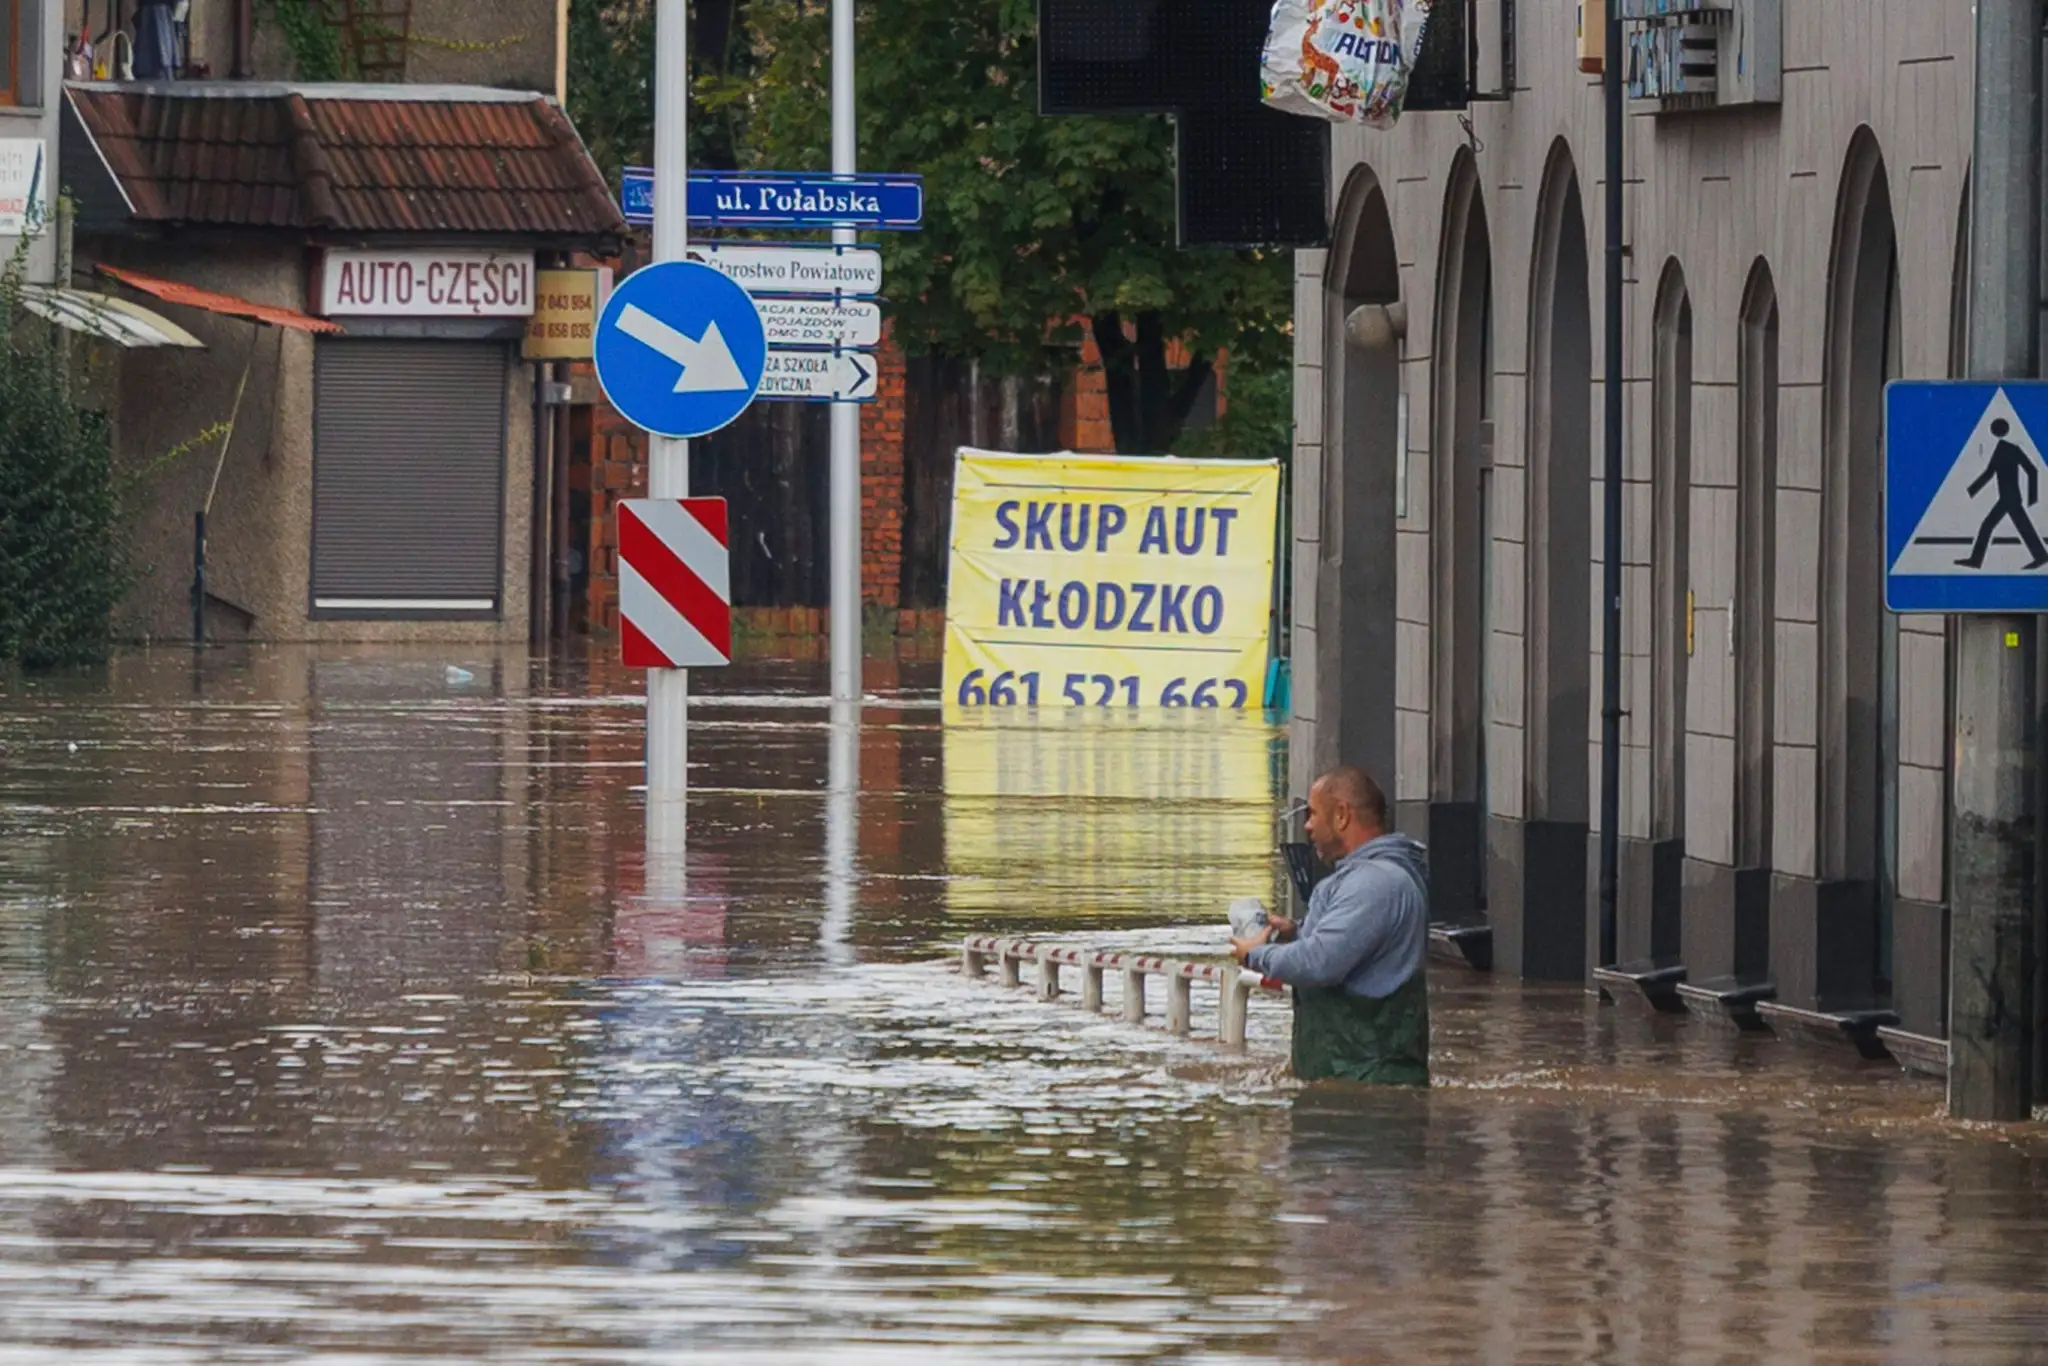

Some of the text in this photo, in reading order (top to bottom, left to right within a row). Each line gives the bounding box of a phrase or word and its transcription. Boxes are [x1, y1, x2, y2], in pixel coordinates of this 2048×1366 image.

[716, 187, 882, 213] ul. Połabska
[790, 260, 876, 282] Powiatowe
[337, 253, 528, 313] AUTO-CZĘŚCI
[757, 304, 795, 315] ACJA
[766, 316, 847, 328] POJAZDÓW
[767, 328, 800, 338] DMC
[802, 329, 824, 339] DO
[850, 330, 858, 340] T
[783, 358, 829, 373] SZKOŁA
[759, 376, 812, 392] EDYCZNA
[992, 500, 1239, 557] SKUP AUT
[997, 577, 1224, 635] KŁODZKO
[958, 668, 1249, 710] 661 521 662
